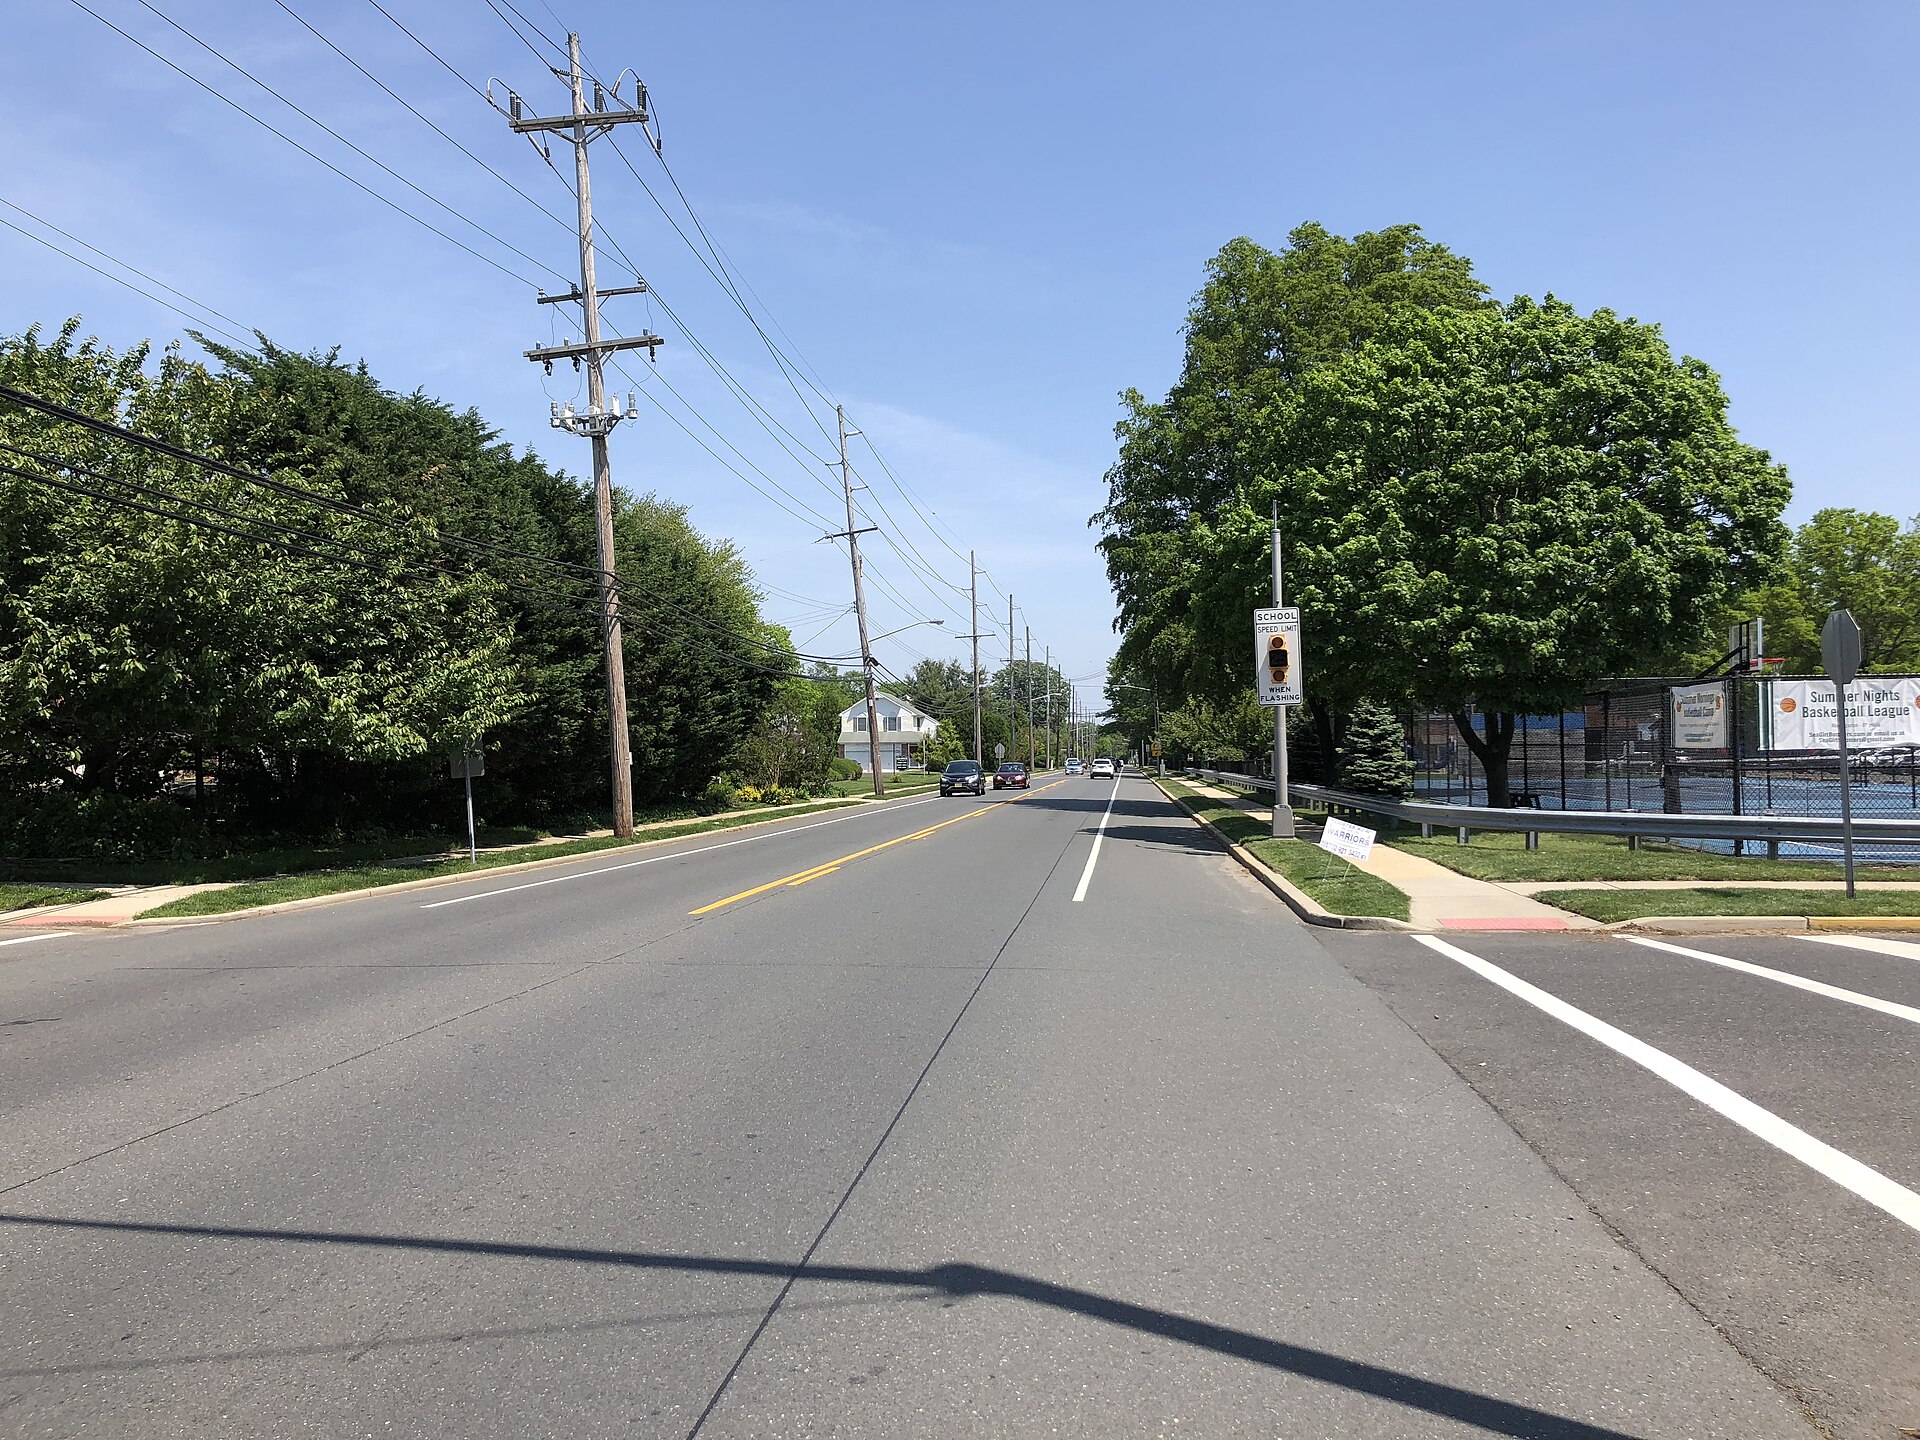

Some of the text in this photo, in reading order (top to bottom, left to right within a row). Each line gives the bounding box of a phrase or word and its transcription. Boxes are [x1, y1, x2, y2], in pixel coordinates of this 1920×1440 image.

[1257, 612, 1297, 621] SCHOOL
[1257, 624, 1297, 634] SPEED LIMIT
[1260, 694, 1300, 702] FLASHING
[1863, 690, 1900, 704] Nights
[1802, 704, 1910, 719] Baskeall League
[1327, 828, 1370, 847] WARRIORS
